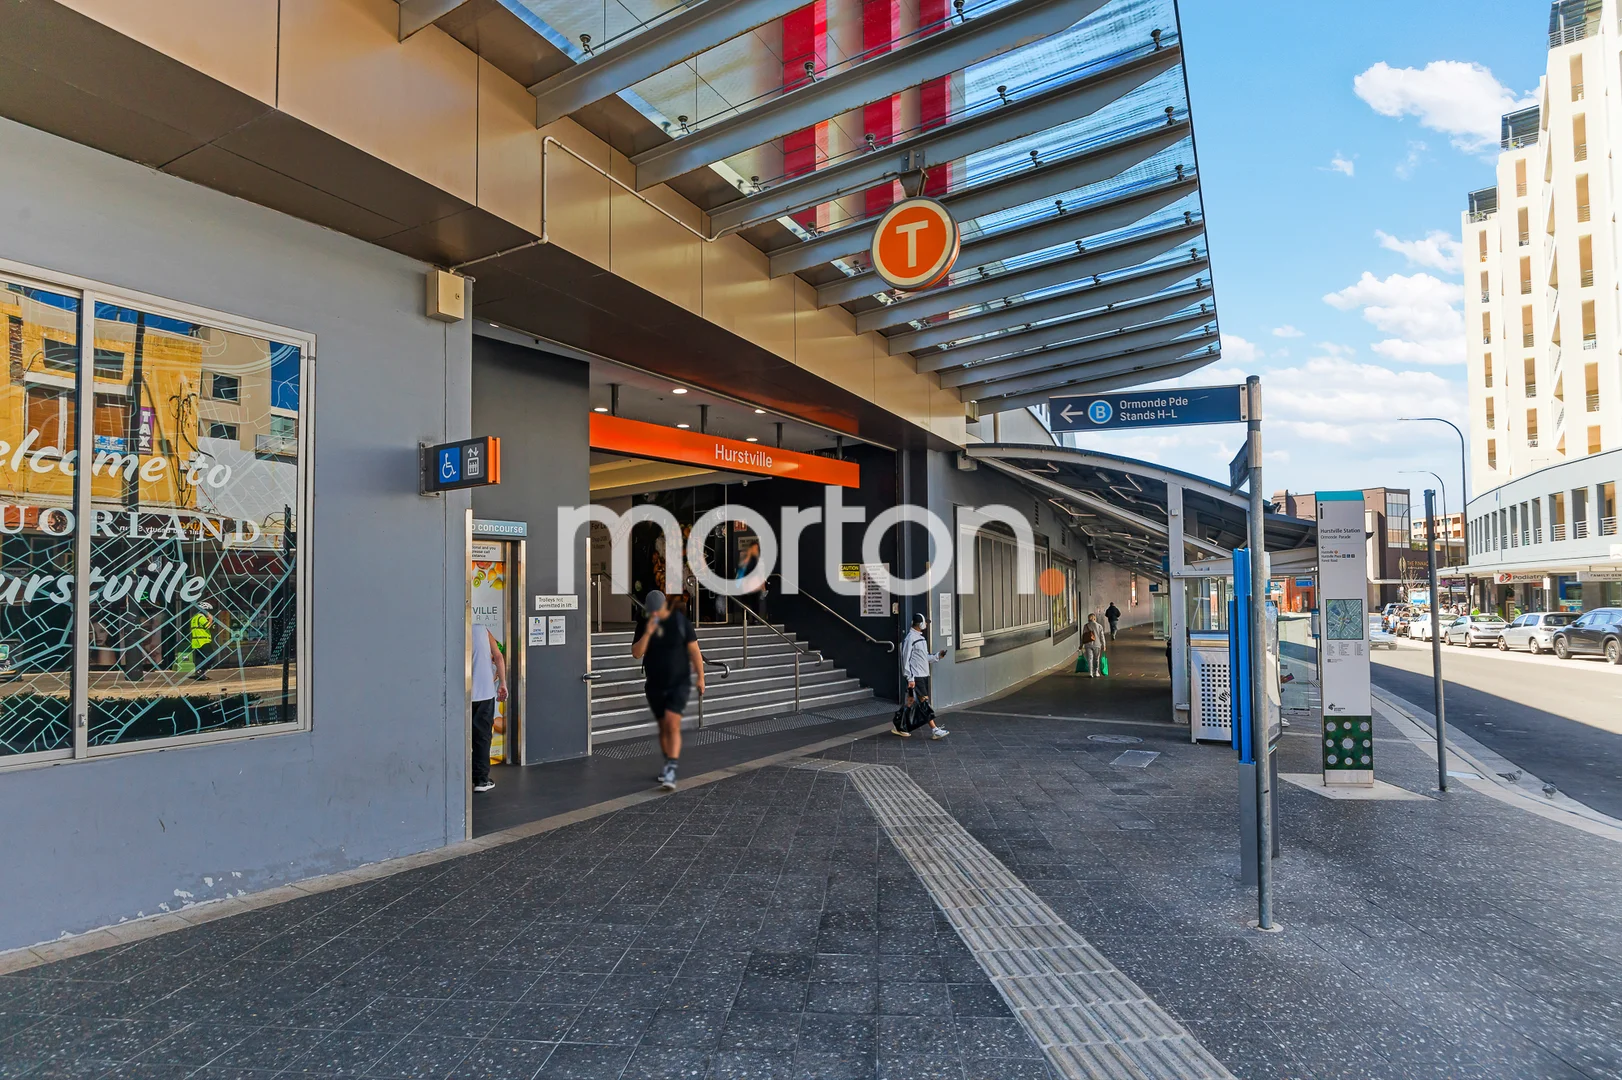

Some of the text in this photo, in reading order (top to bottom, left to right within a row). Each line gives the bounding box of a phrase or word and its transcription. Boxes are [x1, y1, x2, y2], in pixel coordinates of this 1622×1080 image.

[895, 219, 928, 268] T
[1119, 396, 1189, 410] Ormonde Pde
[1119, 410, 1156, 422] Stands
[139, 411, 151, 448] TAX
[715, 443, 773, 469] Hurstville
[186, 454, 232, 489] to
[478, 523, 524, 534] concourse
[472, 606, 498, 615] VILLE
